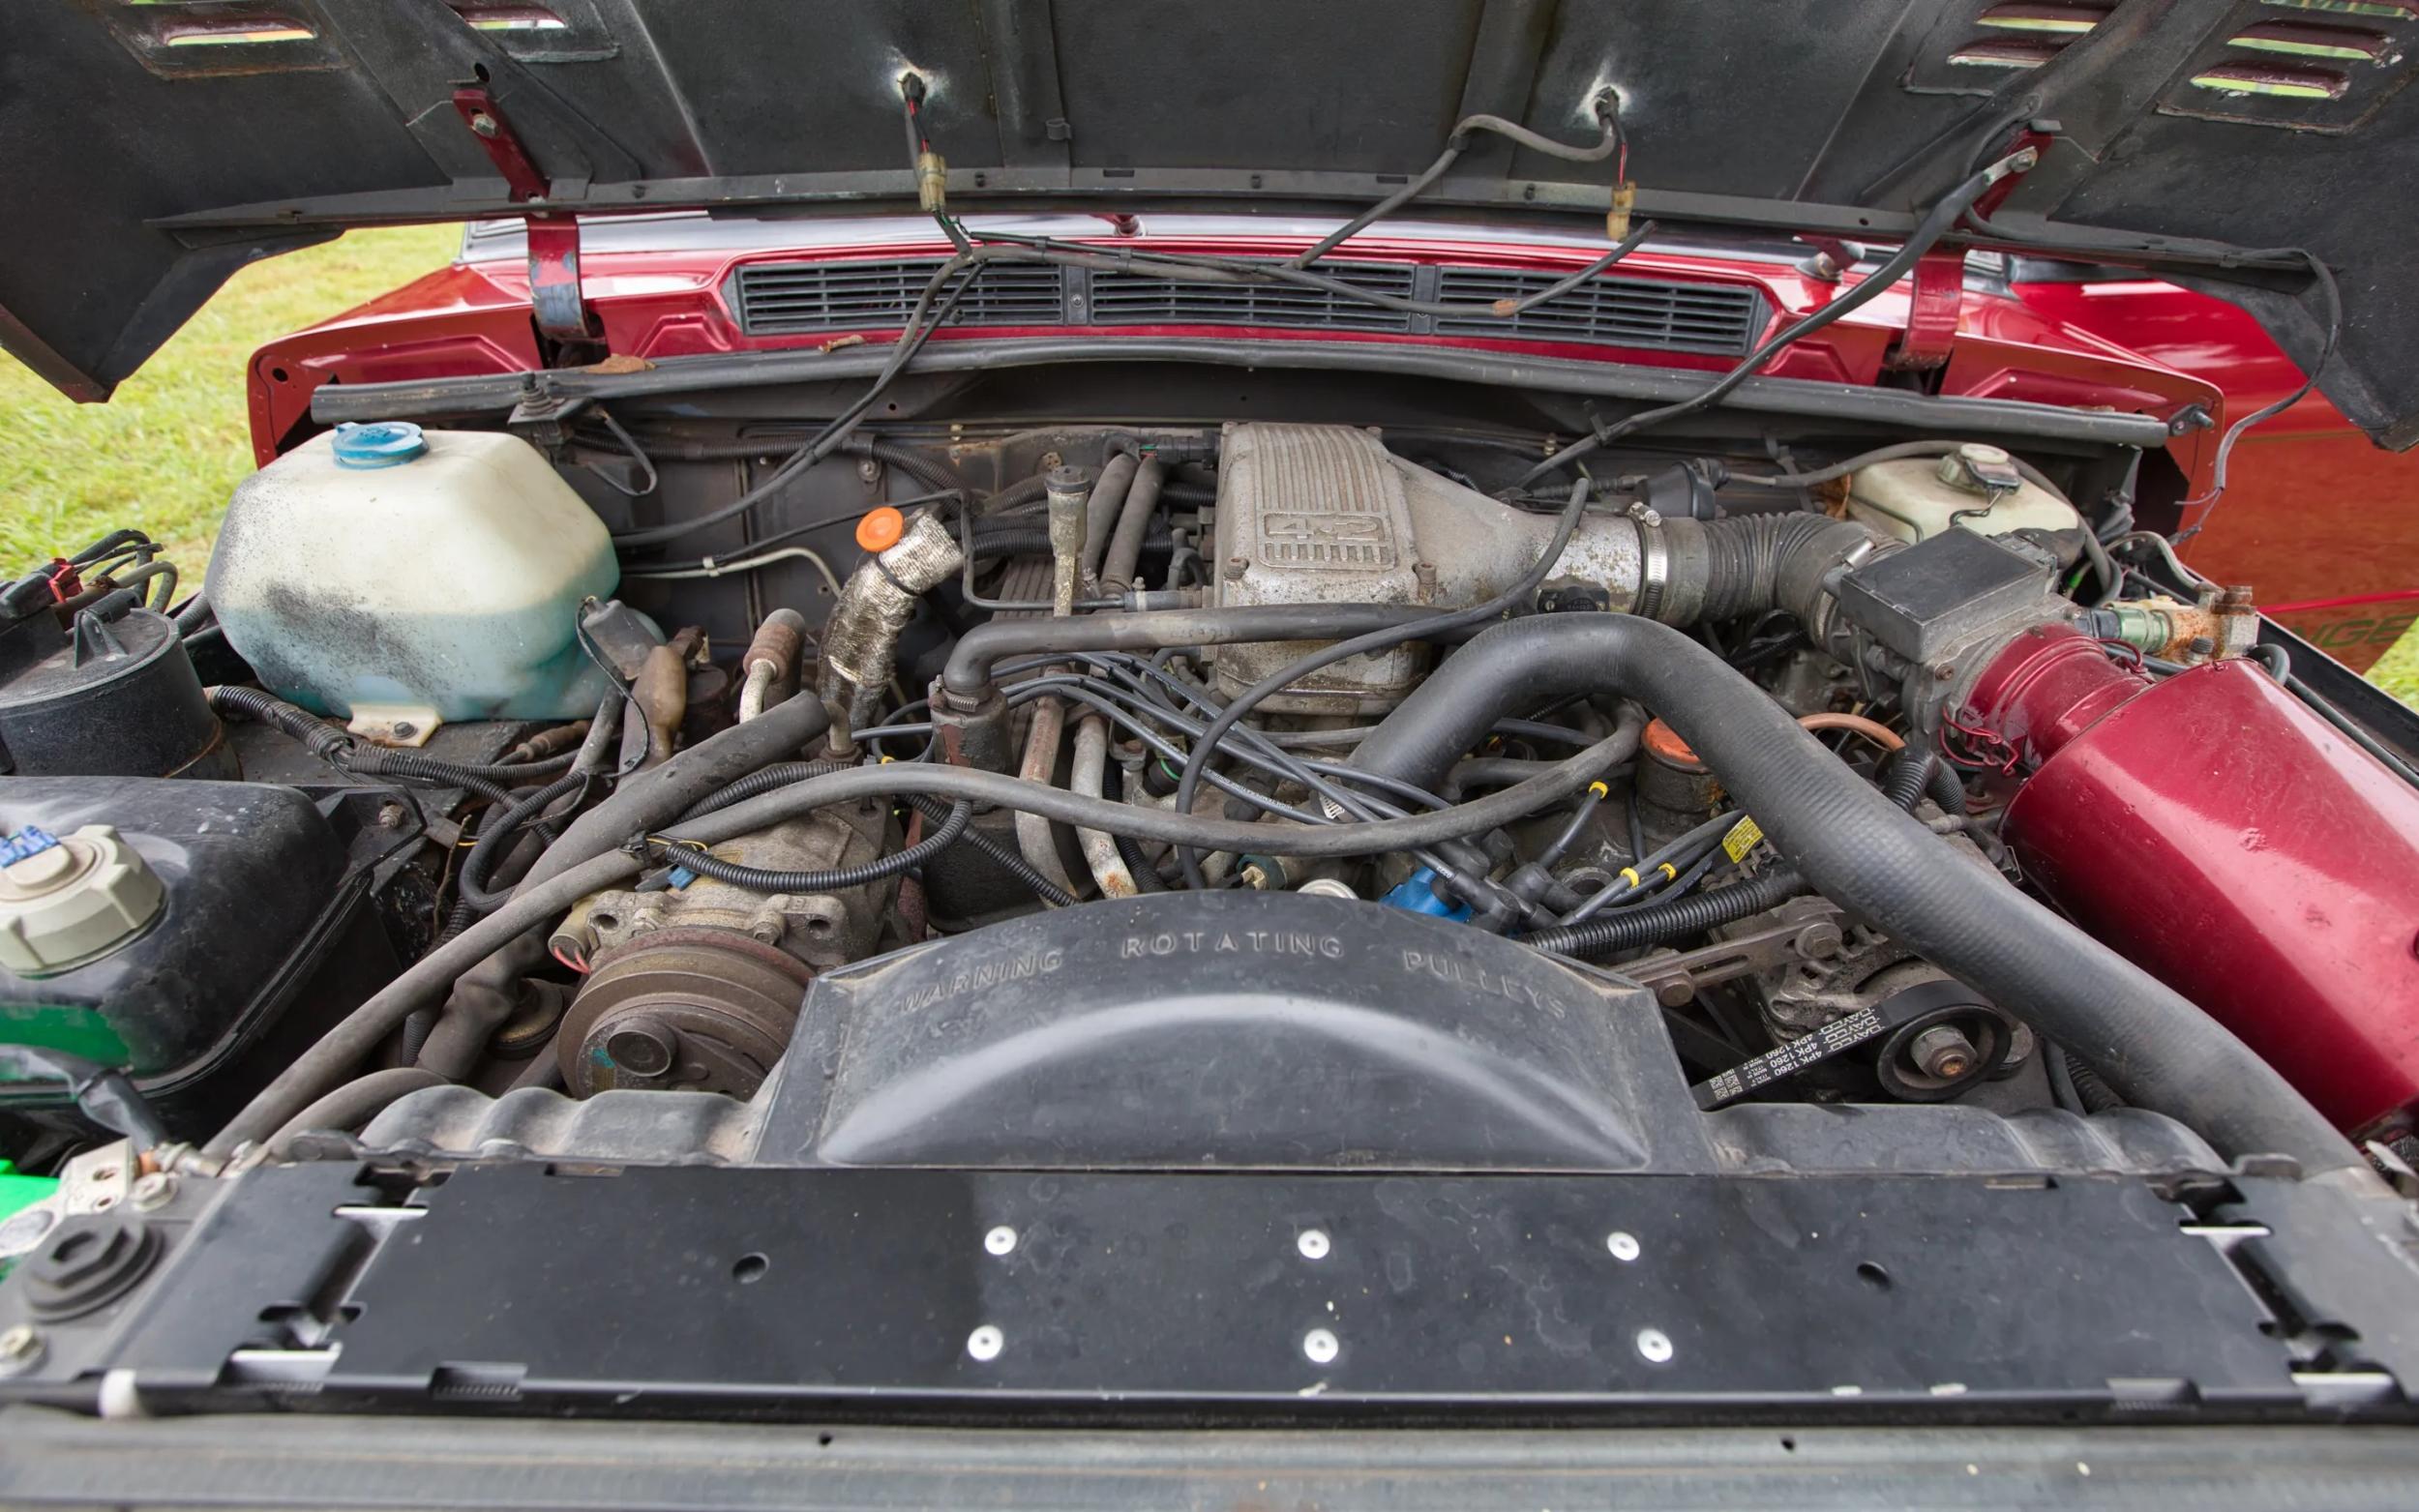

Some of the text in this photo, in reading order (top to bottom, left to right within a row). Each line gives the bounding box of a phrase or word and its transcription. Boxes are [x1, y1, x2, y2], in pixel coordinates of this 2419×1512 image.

[901, 932, 1567, 1019] WARNING ROTATING PULLEYS
[1766, 1007, 1874, 1059] DAYCO 4PK 1260
[1770, 1016, 1876, 1068] DAYCO 4PK 1260
[1774, 1024, 1882, 1076] DAYCO 4PK 1260
